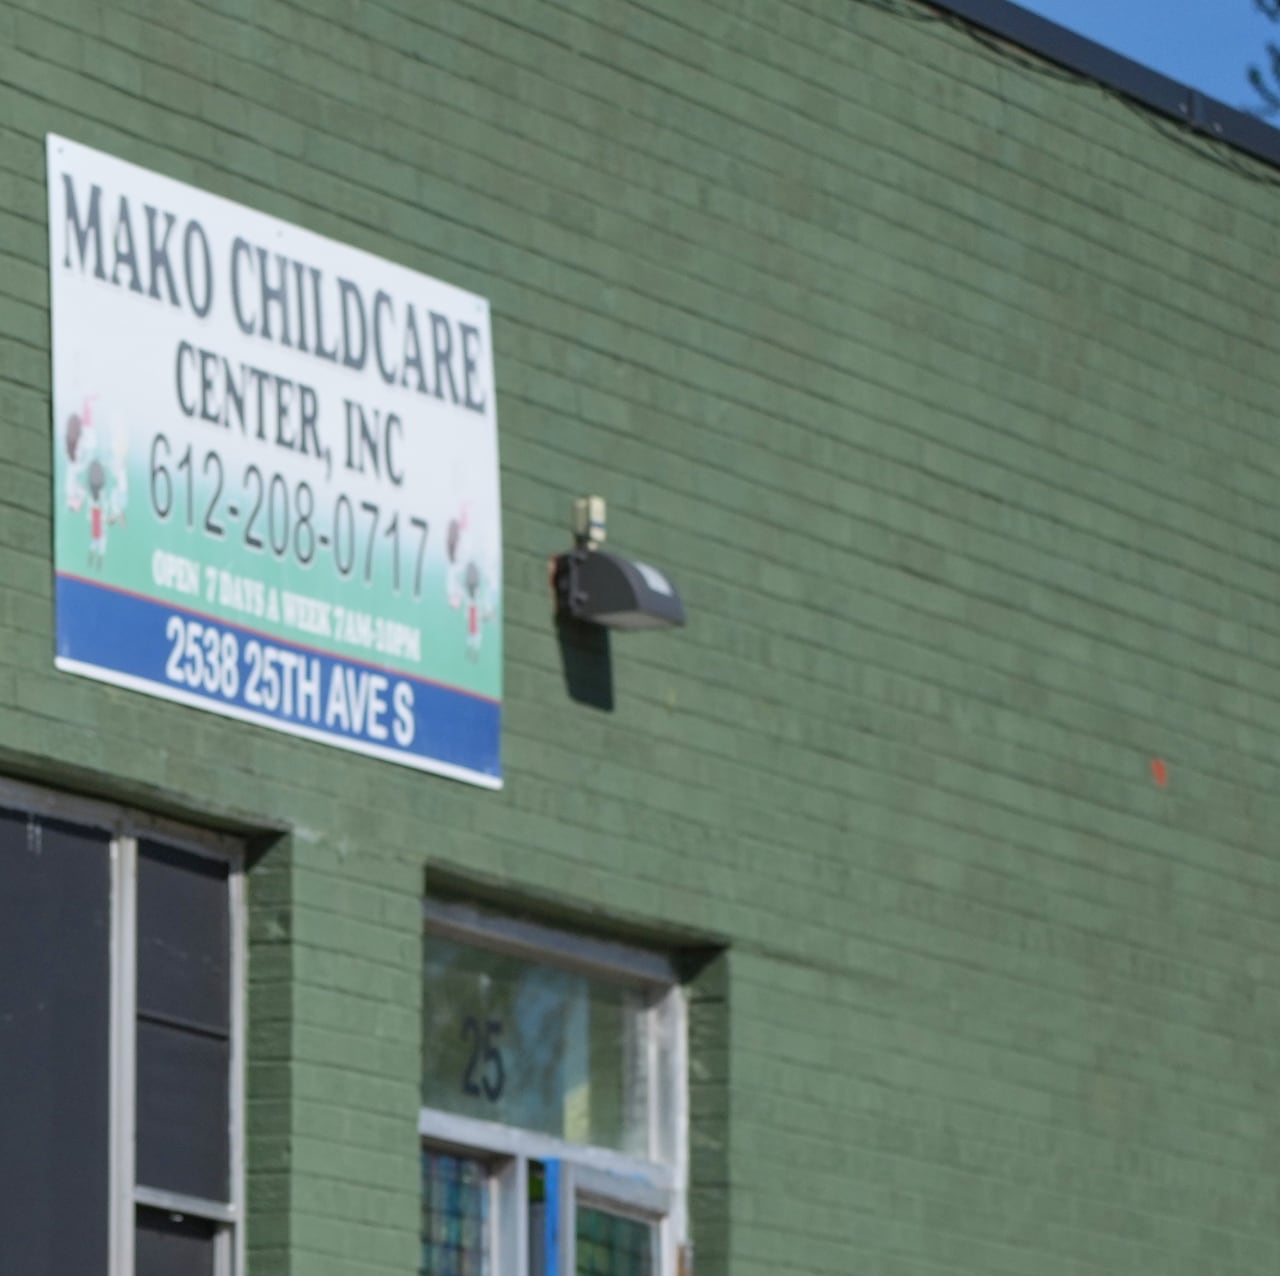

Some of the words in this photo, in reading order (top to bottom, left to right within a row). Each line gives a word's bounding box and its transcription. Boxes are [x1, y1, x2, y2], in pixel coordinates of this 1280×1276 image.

[62, 173, 213, 319] MAKO
[230, 237, 486, 416] CHILDCARE
[176, 340, 332, 481] CENTER,
[343, 398, 404, 487] INC
[150, 433, 429, 598] 612-208-0717
[152, 549, 200, 597] OPEN
[205, 566, 217, 602] 7
[220, 570, 264, 617] DAYS
[266, 587, 279, 623] A
[282, 590, 331, 638] WEEK
[166, 615, 239, 699] 2538
[244, 640, 321, 723] 25TH
[326, 663, 389, 741] AVE
[393, 681, 415, 747] S
